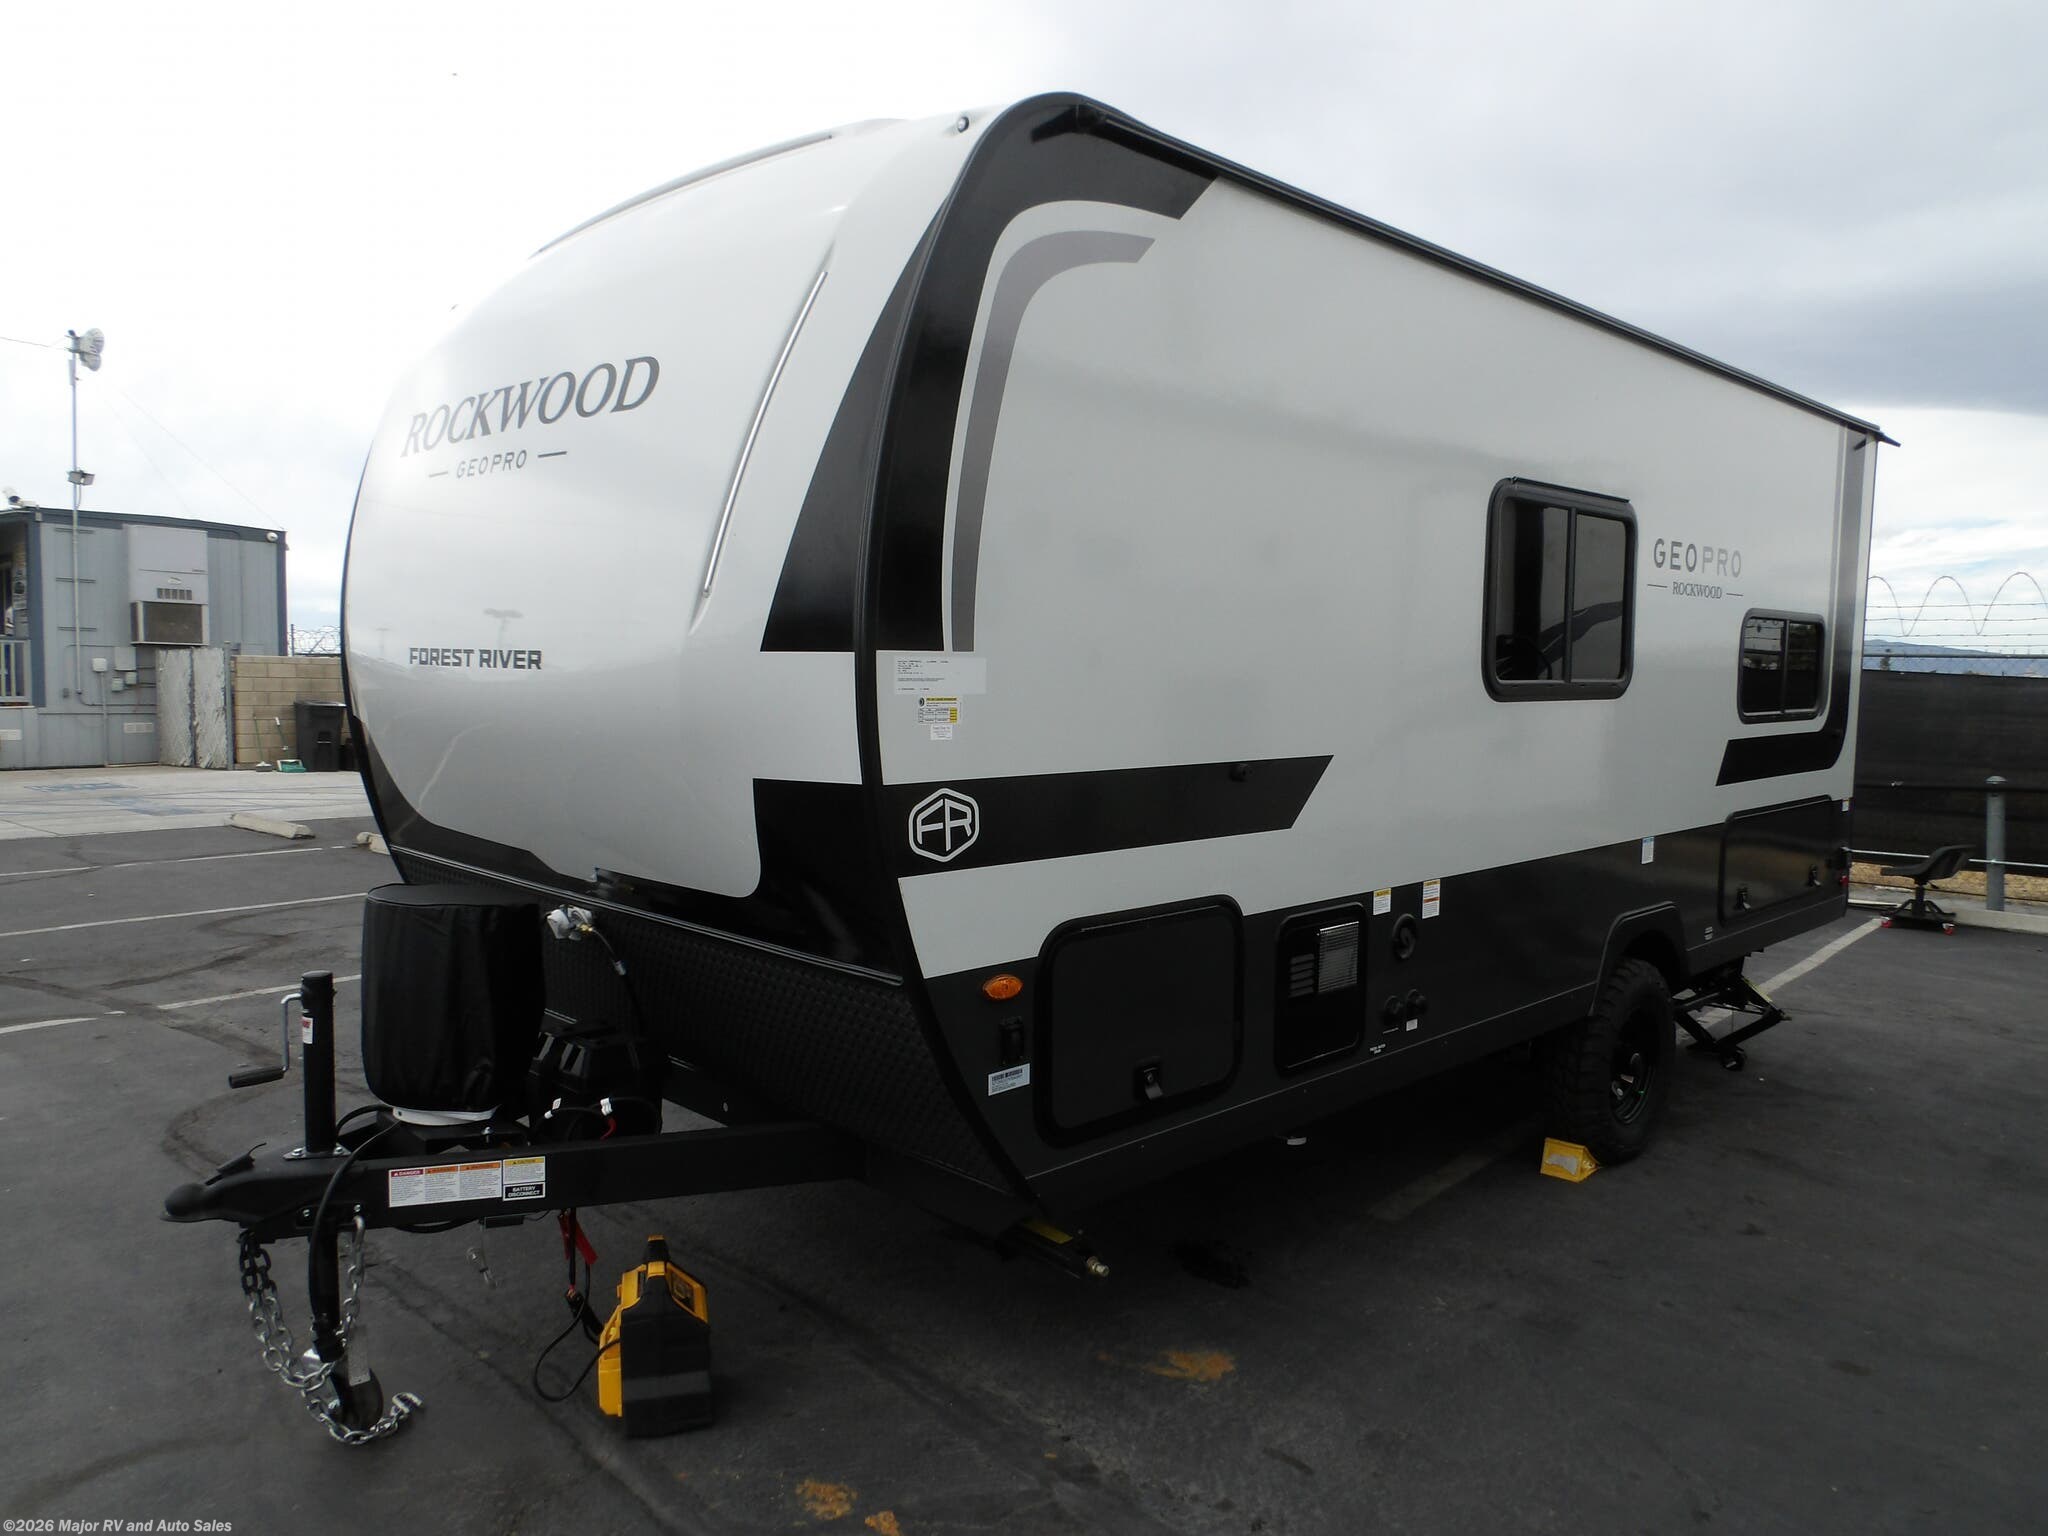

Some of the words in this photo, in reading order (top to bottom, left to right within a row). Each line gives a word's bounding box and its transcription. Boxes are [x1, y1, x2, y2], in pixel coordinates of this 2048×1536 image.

[400, 355, 660, 457] ROCKWOOD
[456, 449, 527, 479] GEOPRO
[1653, 538, 1742, 578] GEOPRO
[1672, 581, 1723, 599] ROCKWOOD
[409, 647, 475, 667] FOREST
[478, 649, 542, 670] RIVER
